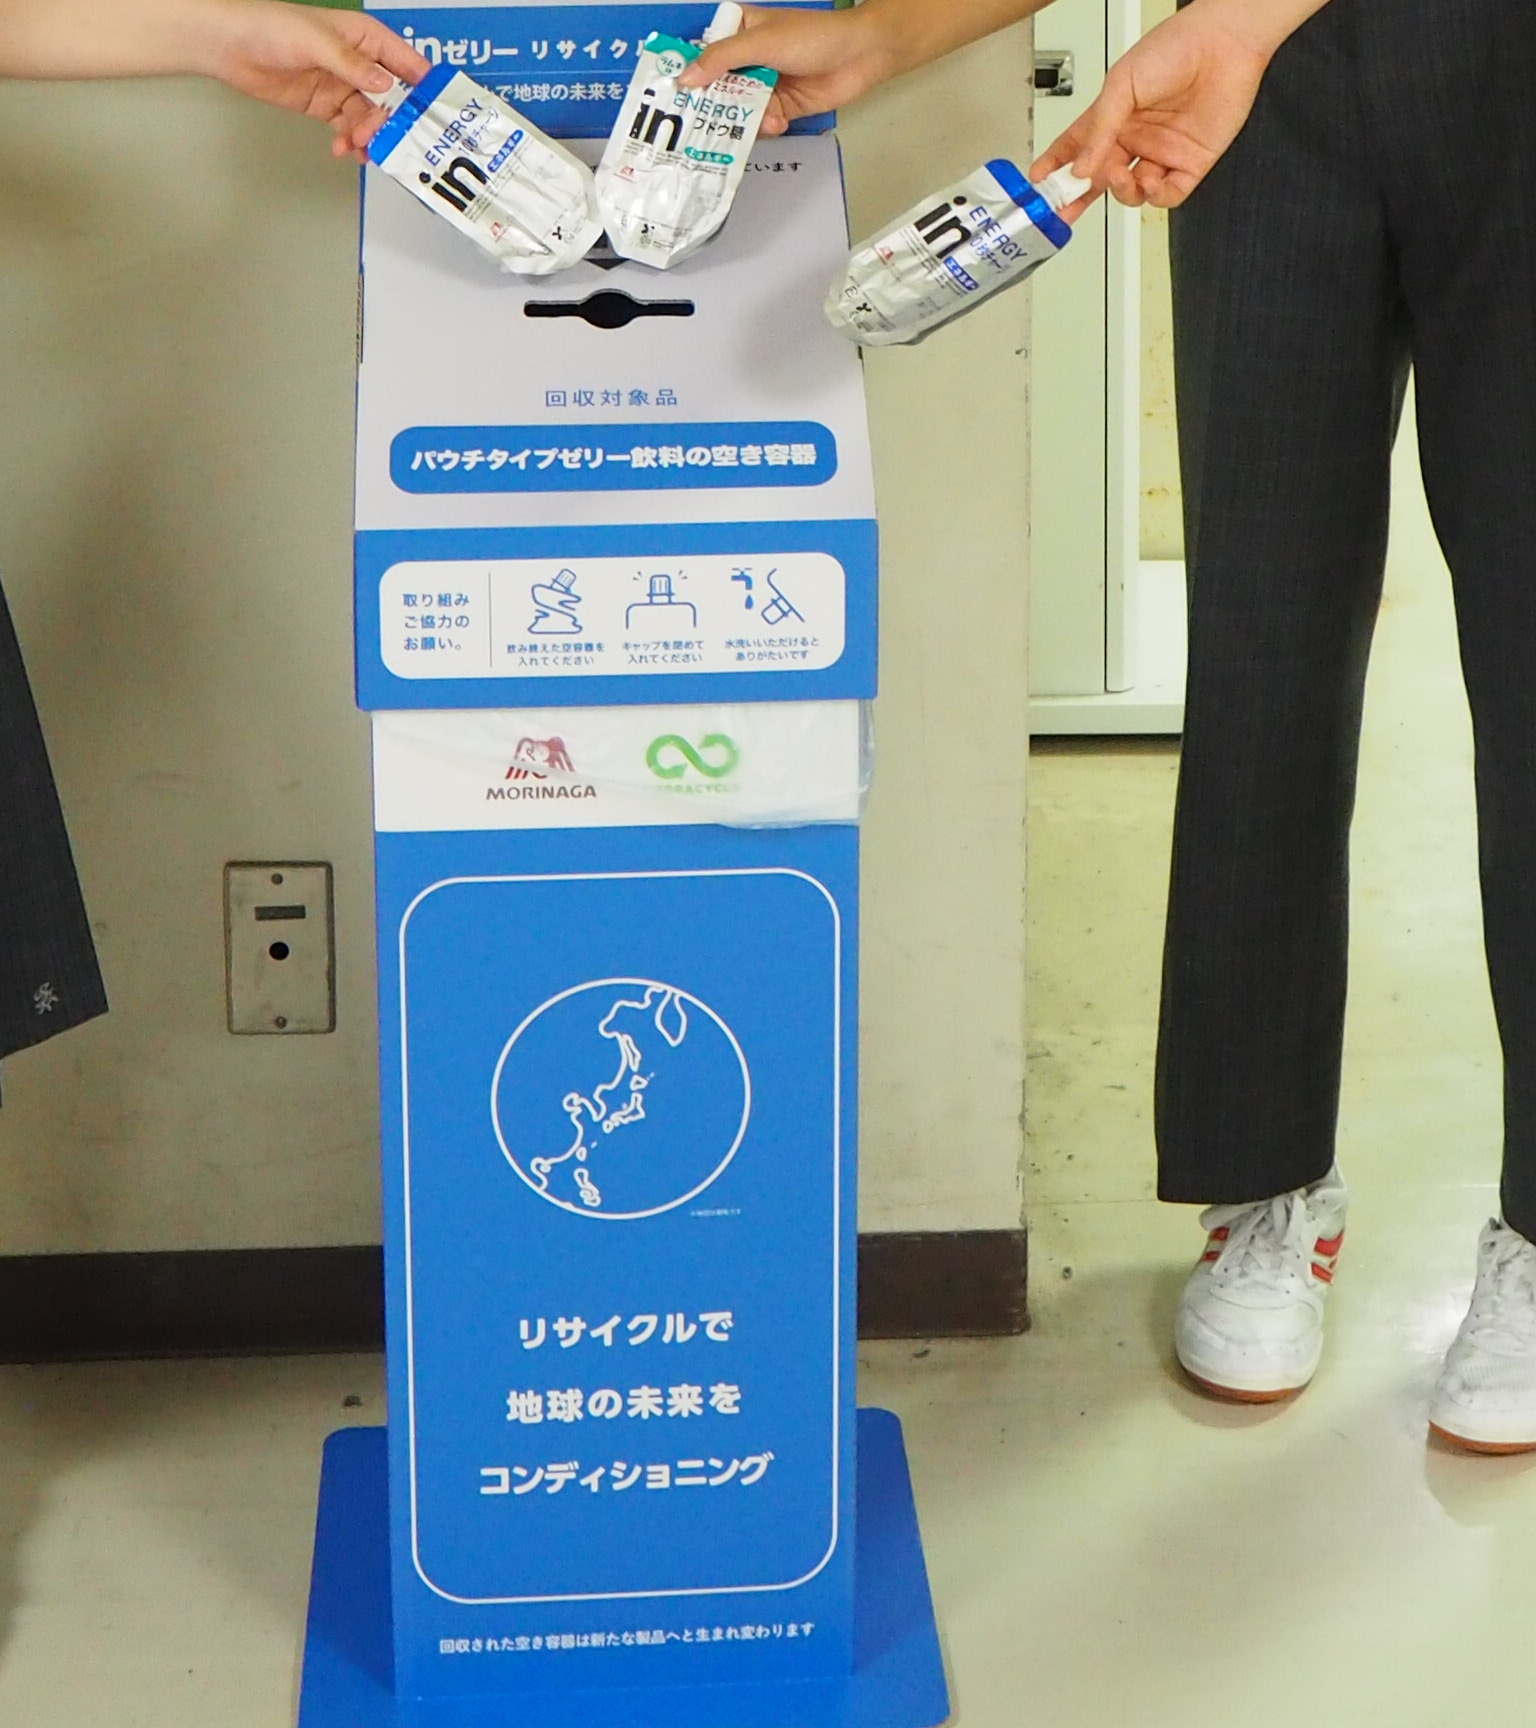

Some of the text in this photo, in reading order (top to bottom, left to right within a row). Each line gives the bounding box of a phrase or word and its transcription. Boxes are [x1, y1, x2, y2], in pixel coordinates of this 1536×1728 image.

[628, 87, 684, 152] in
[672, 89, 755, 123] ENERGY
[424, 97, 484, 168] ENERGY
[418, 155, 491, 213] in
[913, 195, 973, 260] in
[968, 205, 1029, 262] ENERGY
[544, 388, 679, 409] 回収対象品
[410, 442, 818, 472] パウチタイプゼリー飲料の空き容器
[402, 591, 470, 609] 取り組み
[402, 613, 471, 631] ご協力の
[402, 635, 464, 653] お願い。
[621, 639, 705, 652] キャップを閉めて
[627, 652, 704, 664] 入れてください
[724, 636, 821, 650] 水洗いいただけると
[735, 649, 810, 662] ありがたいです
[517, 654, 596, 667] 入れてください
[485, 784, 598, 801] MORINAGA
[518, 1311, 735, 1350] リサイクルで
[506, 1383, 742, 1424] 地球の未来を
[480, 1451, 775, 1496] コンディショニング
[439, 1621, 816, 1655] 回収された空き容器は新たな製品へと生まれ変わります
